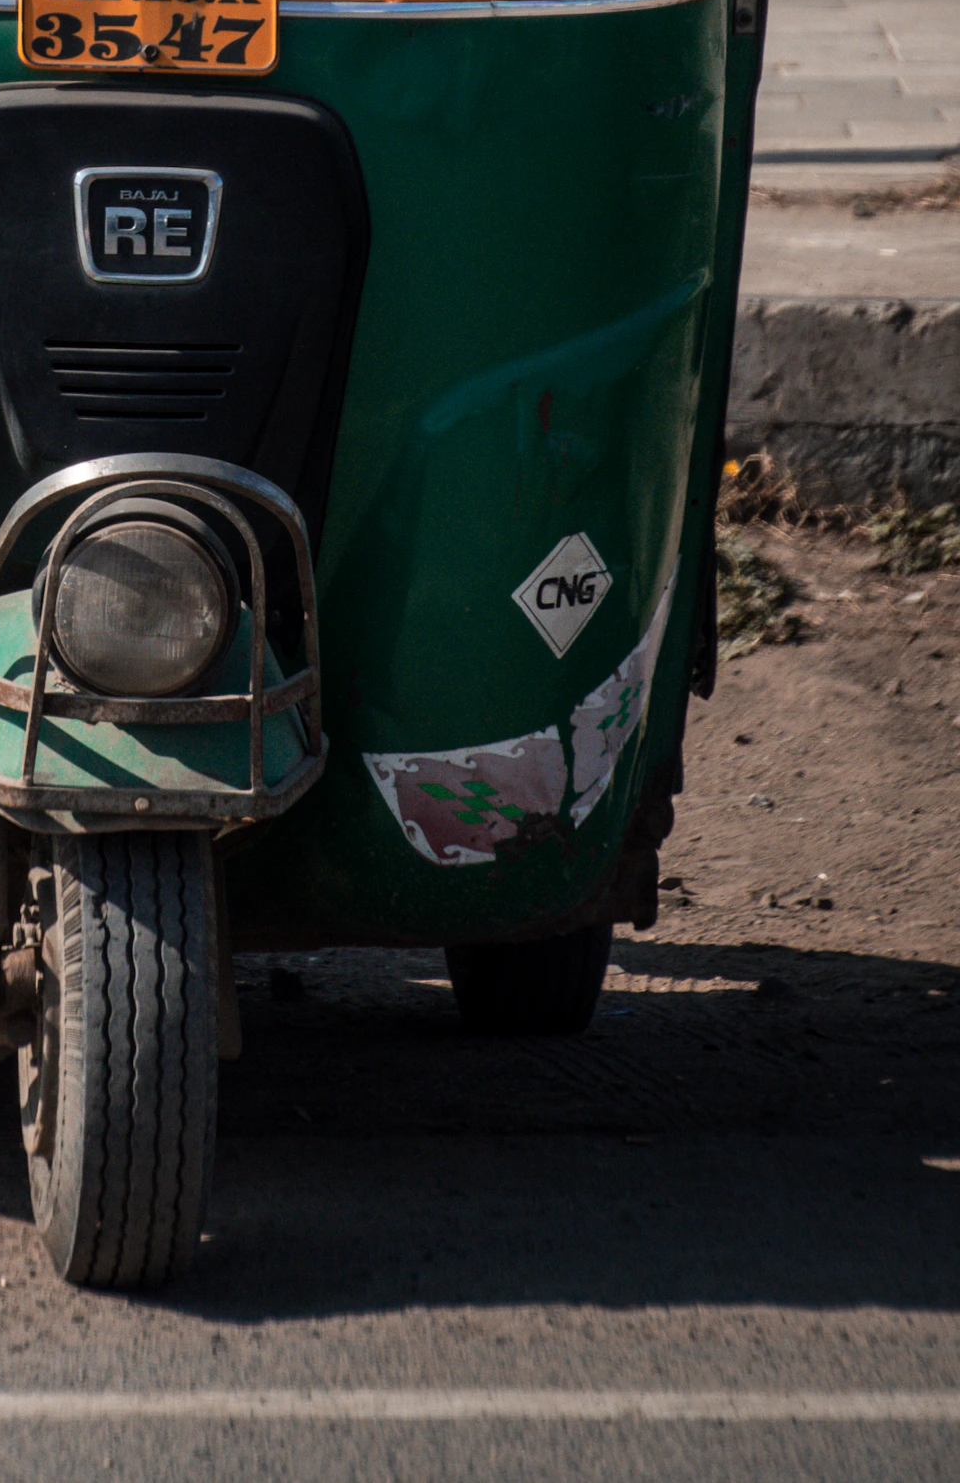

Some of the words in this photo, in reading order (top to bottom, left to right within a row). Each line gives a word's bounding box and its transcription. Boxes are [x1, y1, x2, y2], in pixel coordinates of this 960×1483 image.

[119, 189, 179, 201] BAJAJ
[103, 206, 192, 257] RE
[536, 571, 597, 610] CNG
